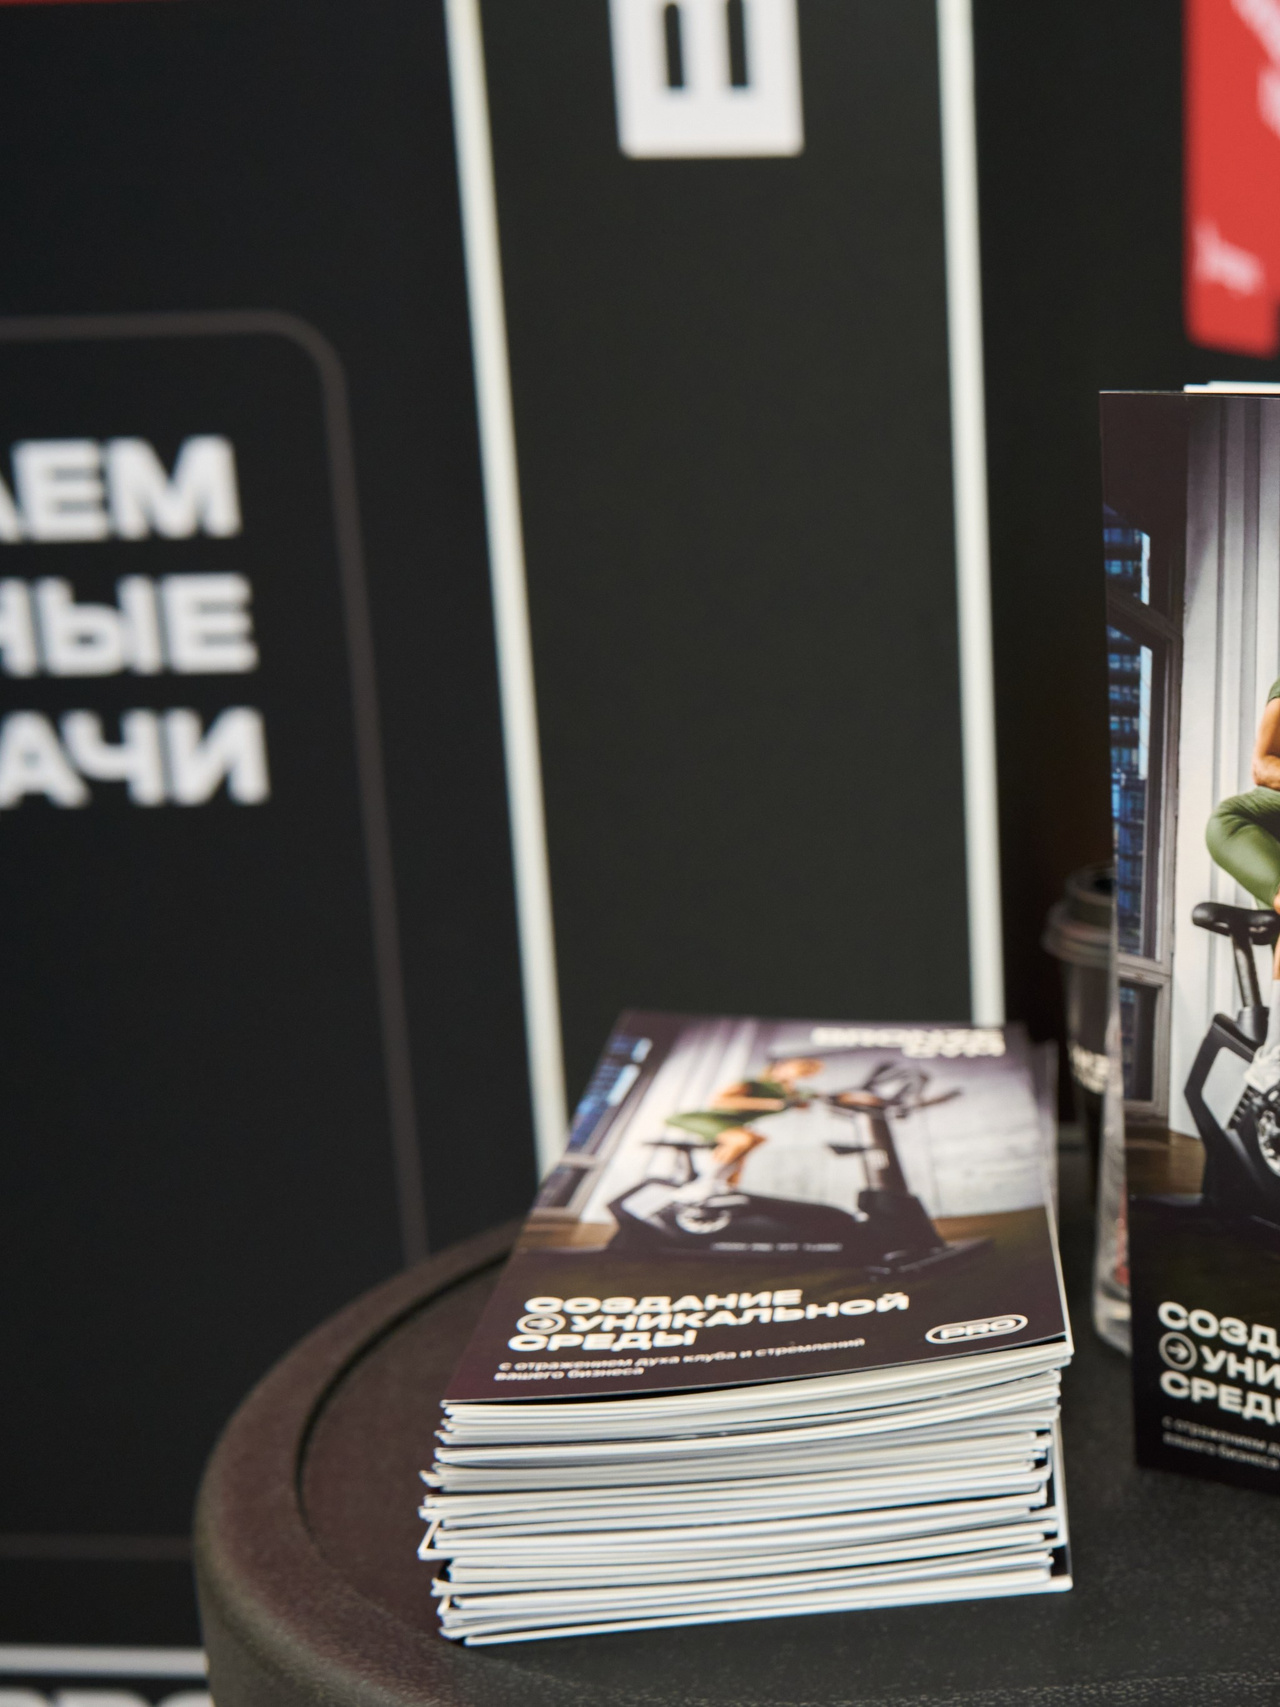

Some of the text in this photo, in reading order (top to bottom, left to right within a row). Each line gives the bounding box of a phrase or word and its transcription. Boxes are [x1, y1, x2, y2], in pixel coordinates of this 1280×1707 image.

[0, 434, 243, 544] ЕМ
[524, 1289, 804, 1316] СОЗДАНИЕ
[570, 1292, 911, 1333] УНИКАЛЬНОЙ
[508, 1329, 698, 1352] СРЕДЫ
[941, 1319, 1017, 1339] PRO
